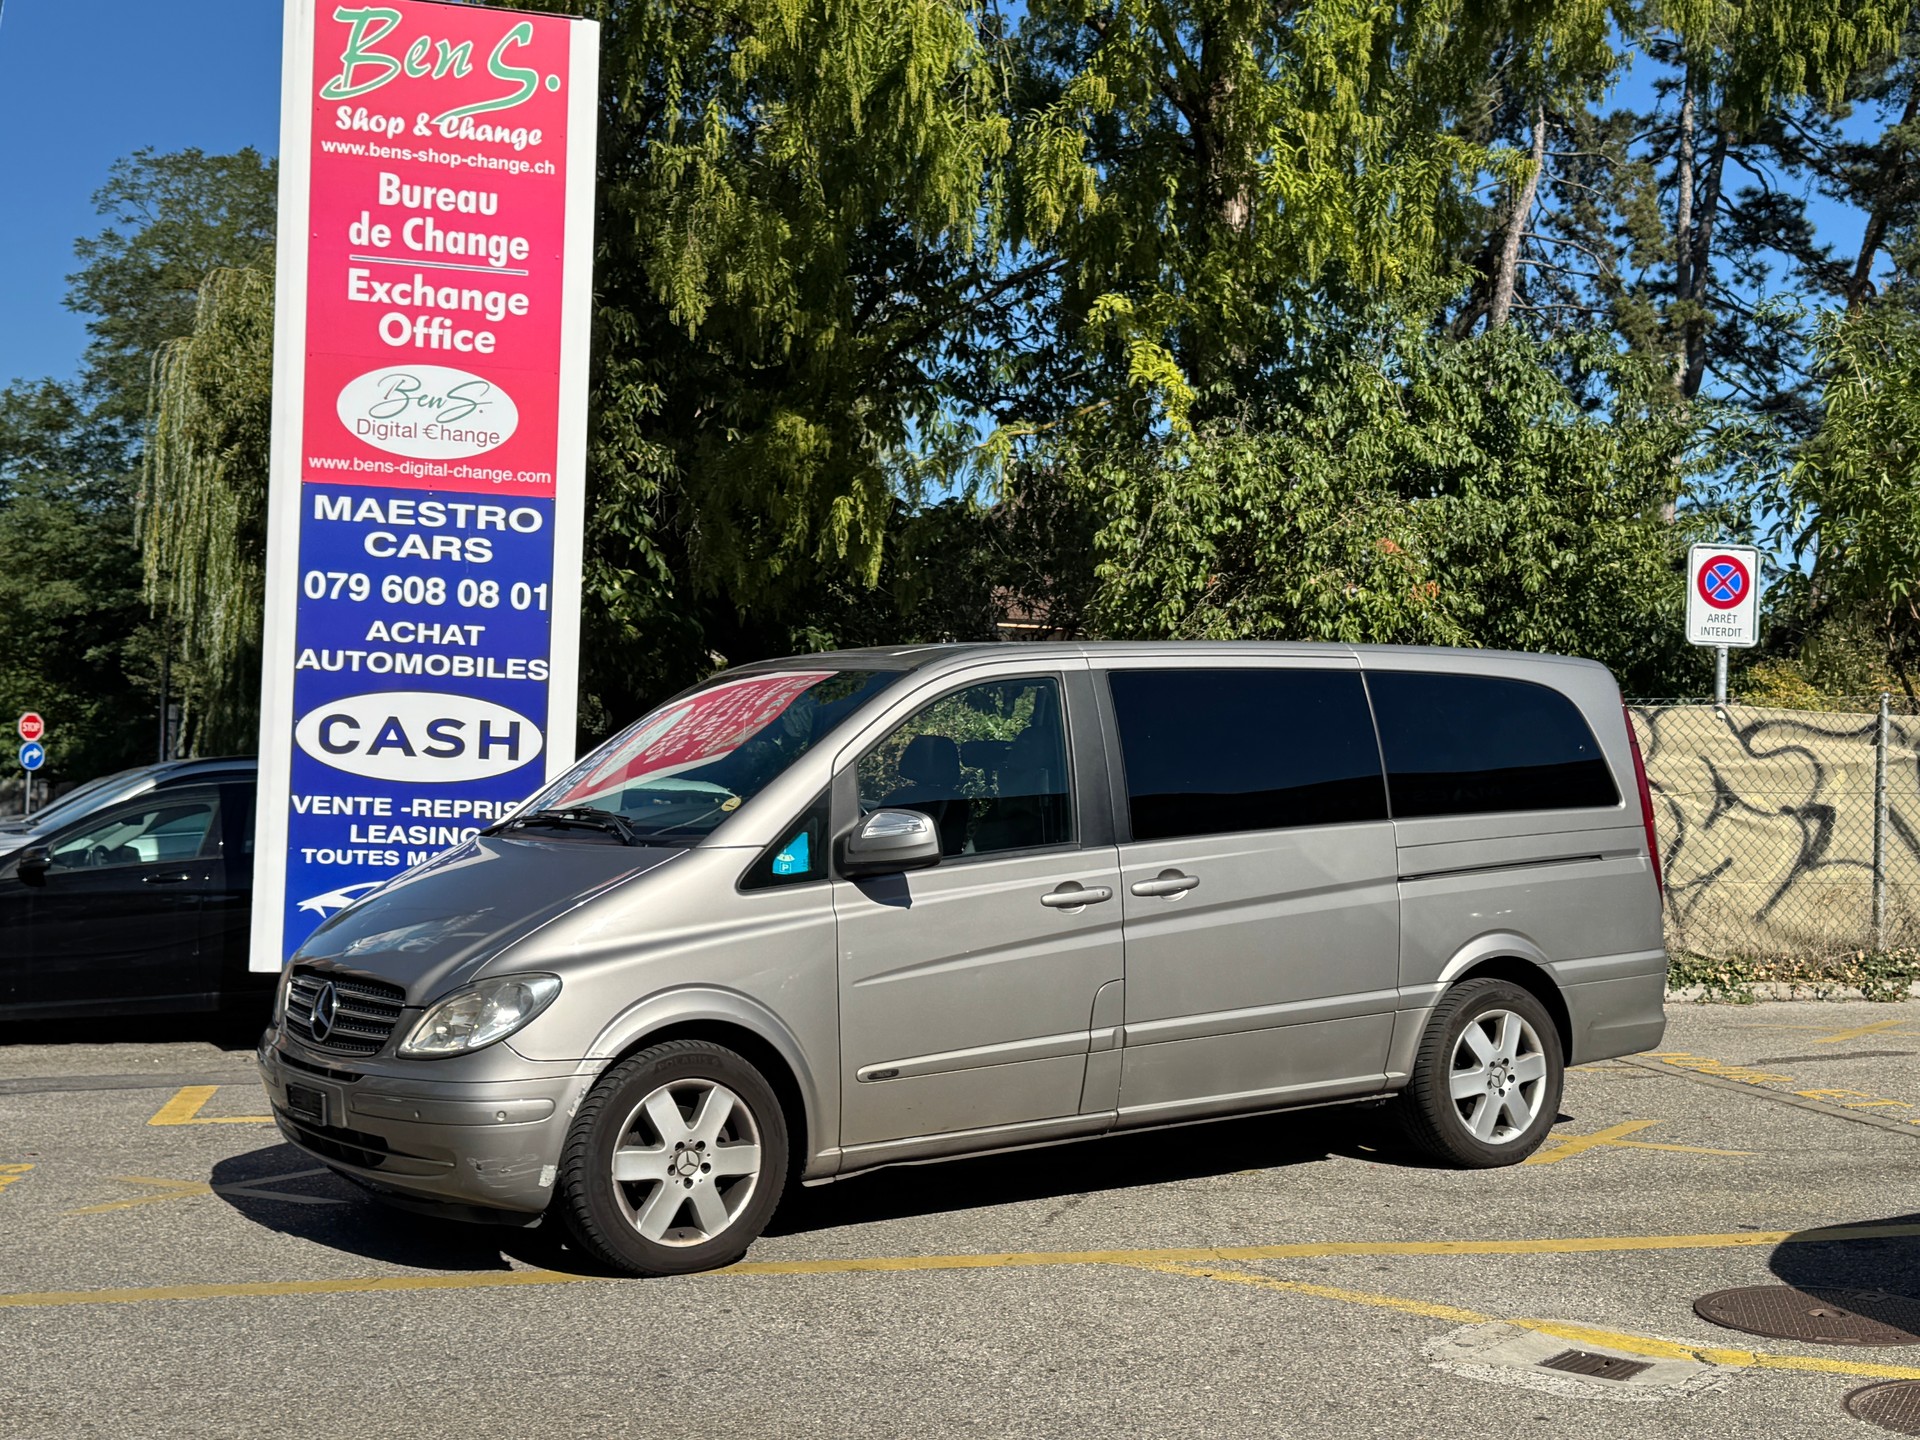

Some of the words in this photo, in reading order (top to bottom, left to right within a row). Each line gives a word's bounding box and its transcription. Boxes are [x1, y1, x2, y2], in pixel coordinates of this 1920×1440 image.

[320, 6, 473, 100] Ben
[335, 106, 405, 139] Shop
[413, 113, 432, 137] &
[439, 116, 542, 151] Change
[321, 140, 555, 175] www.bens-shop-change.ch
[378, 172, 498, 216] Bureau
[349, 211, 391, 248] de
[402, 218, 529, 266] Change
[348, 268, 529, 322] Exchange
[378, 312, 496, 354] Office
[369, 373, 446, 419] Ben
[356, 419, 417, 440] Digital
[308, 455, 551, 484] www.bens-digital-change.com
[314, 495, 543, 533] MAESTRO
[364, 532, 493, 563] CARS
[304, 570, 370, 602] 079
[382, 575, 446, 605] 608
[457, 579, 500, 609] 08
[510, 582, 548, 611] 01
[365, 620, 486, 646] ACHAT
[1701, 626, 1742, 637] INTERDIT
[1707, 612, 1738, 624] ARRÊT
[296, 648, 549, 681] AUTOMOBILES
[22, 722, 41, 732] STOP
[318, 713, 521, 762] CASH
[291, 795, 393, 816] VENTE
[301, 848, 399, 866] TOUTES
